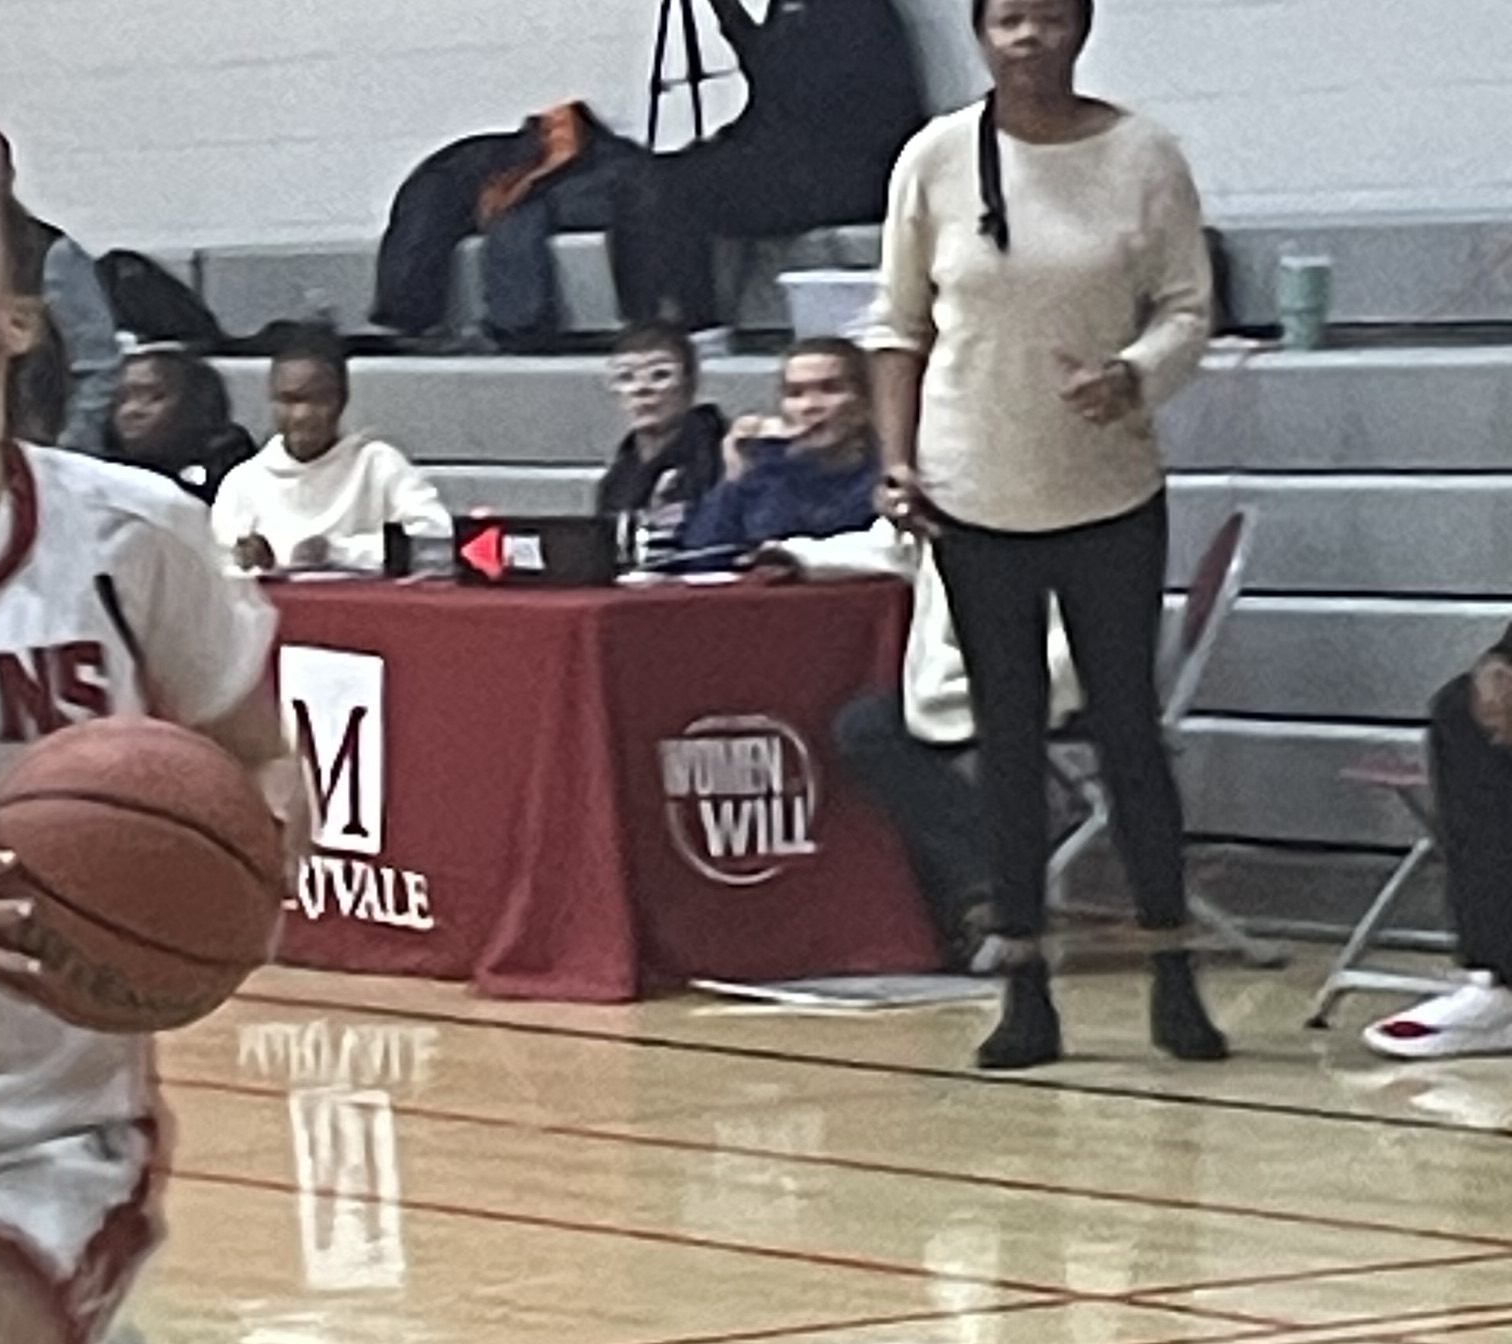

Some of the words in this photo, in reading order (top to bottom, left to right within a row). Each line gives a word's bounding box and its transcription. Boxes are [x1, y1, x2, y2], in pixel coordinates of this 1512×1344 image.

[291, 698, 369, 838] M
[656, 734, 784, 796] WOMEN
[698, 794, 817, 857] WILL
